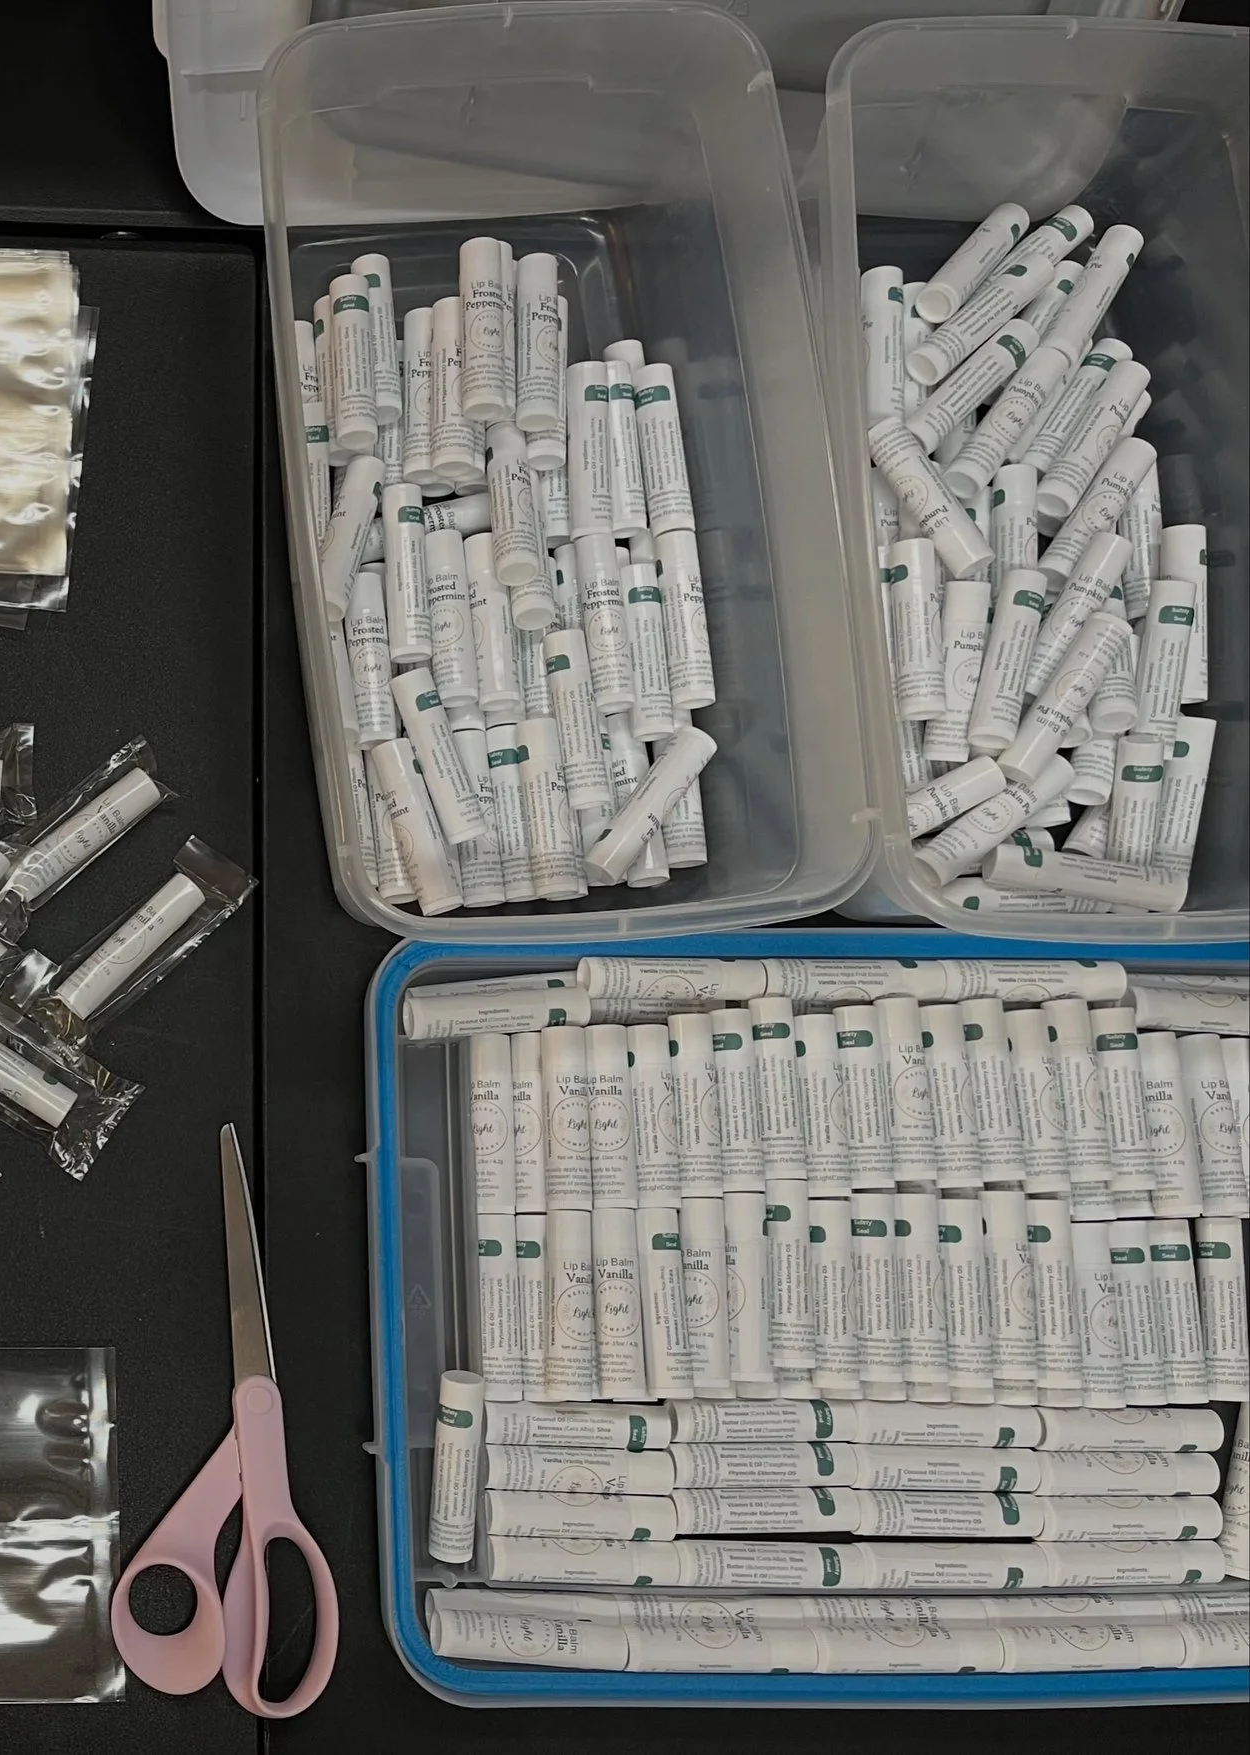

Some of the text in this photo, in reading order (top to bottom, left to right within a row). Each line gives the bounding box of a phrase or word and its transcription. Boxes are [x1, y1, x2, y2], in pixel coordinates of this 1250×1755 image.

[472, 289, 503, 301] Frost
[465, 300, 505, 312] Pepperm
[1018, 376, 1033, 388] Lip
[1113, 471, 1128, 484] Lip
[436, 574, 459, 582] Balm
[427, 582, 457, 594] rosted
[587, 588, 620, 599] Frosted
[350, 617, 364, 627] Lip
[352, 626, 384, 636] Frosted
[960, 630, 976, 640] Lip
[940, 784, 952, 798] Lip
[898, 1045, 914, 1054] Lip
[477, 1080, 501, 1089] Balm
[556, 1074, 571, 1085] Lip
[600, 1074, 624, 1084] Balm
[588, 1085, 623, 1096] Vanilla
[1146, 1080, 1173, 1090] Balm
[1201, 1080, 1217, 1090] Lip
[594, 1118, 619, 1131] Light
[687, 1248, 712, 1258] Balm
[563, 1261, 579, 1272] Lip
[610, 1257, 635, 1267] Balm
[597, 1268, 634, 1280] Vanilla
[1094, 1272, 1109, 1282] Lip
[604, 1304, 630, 1316] Light
[568, 1628, 577, 1655] Balm
